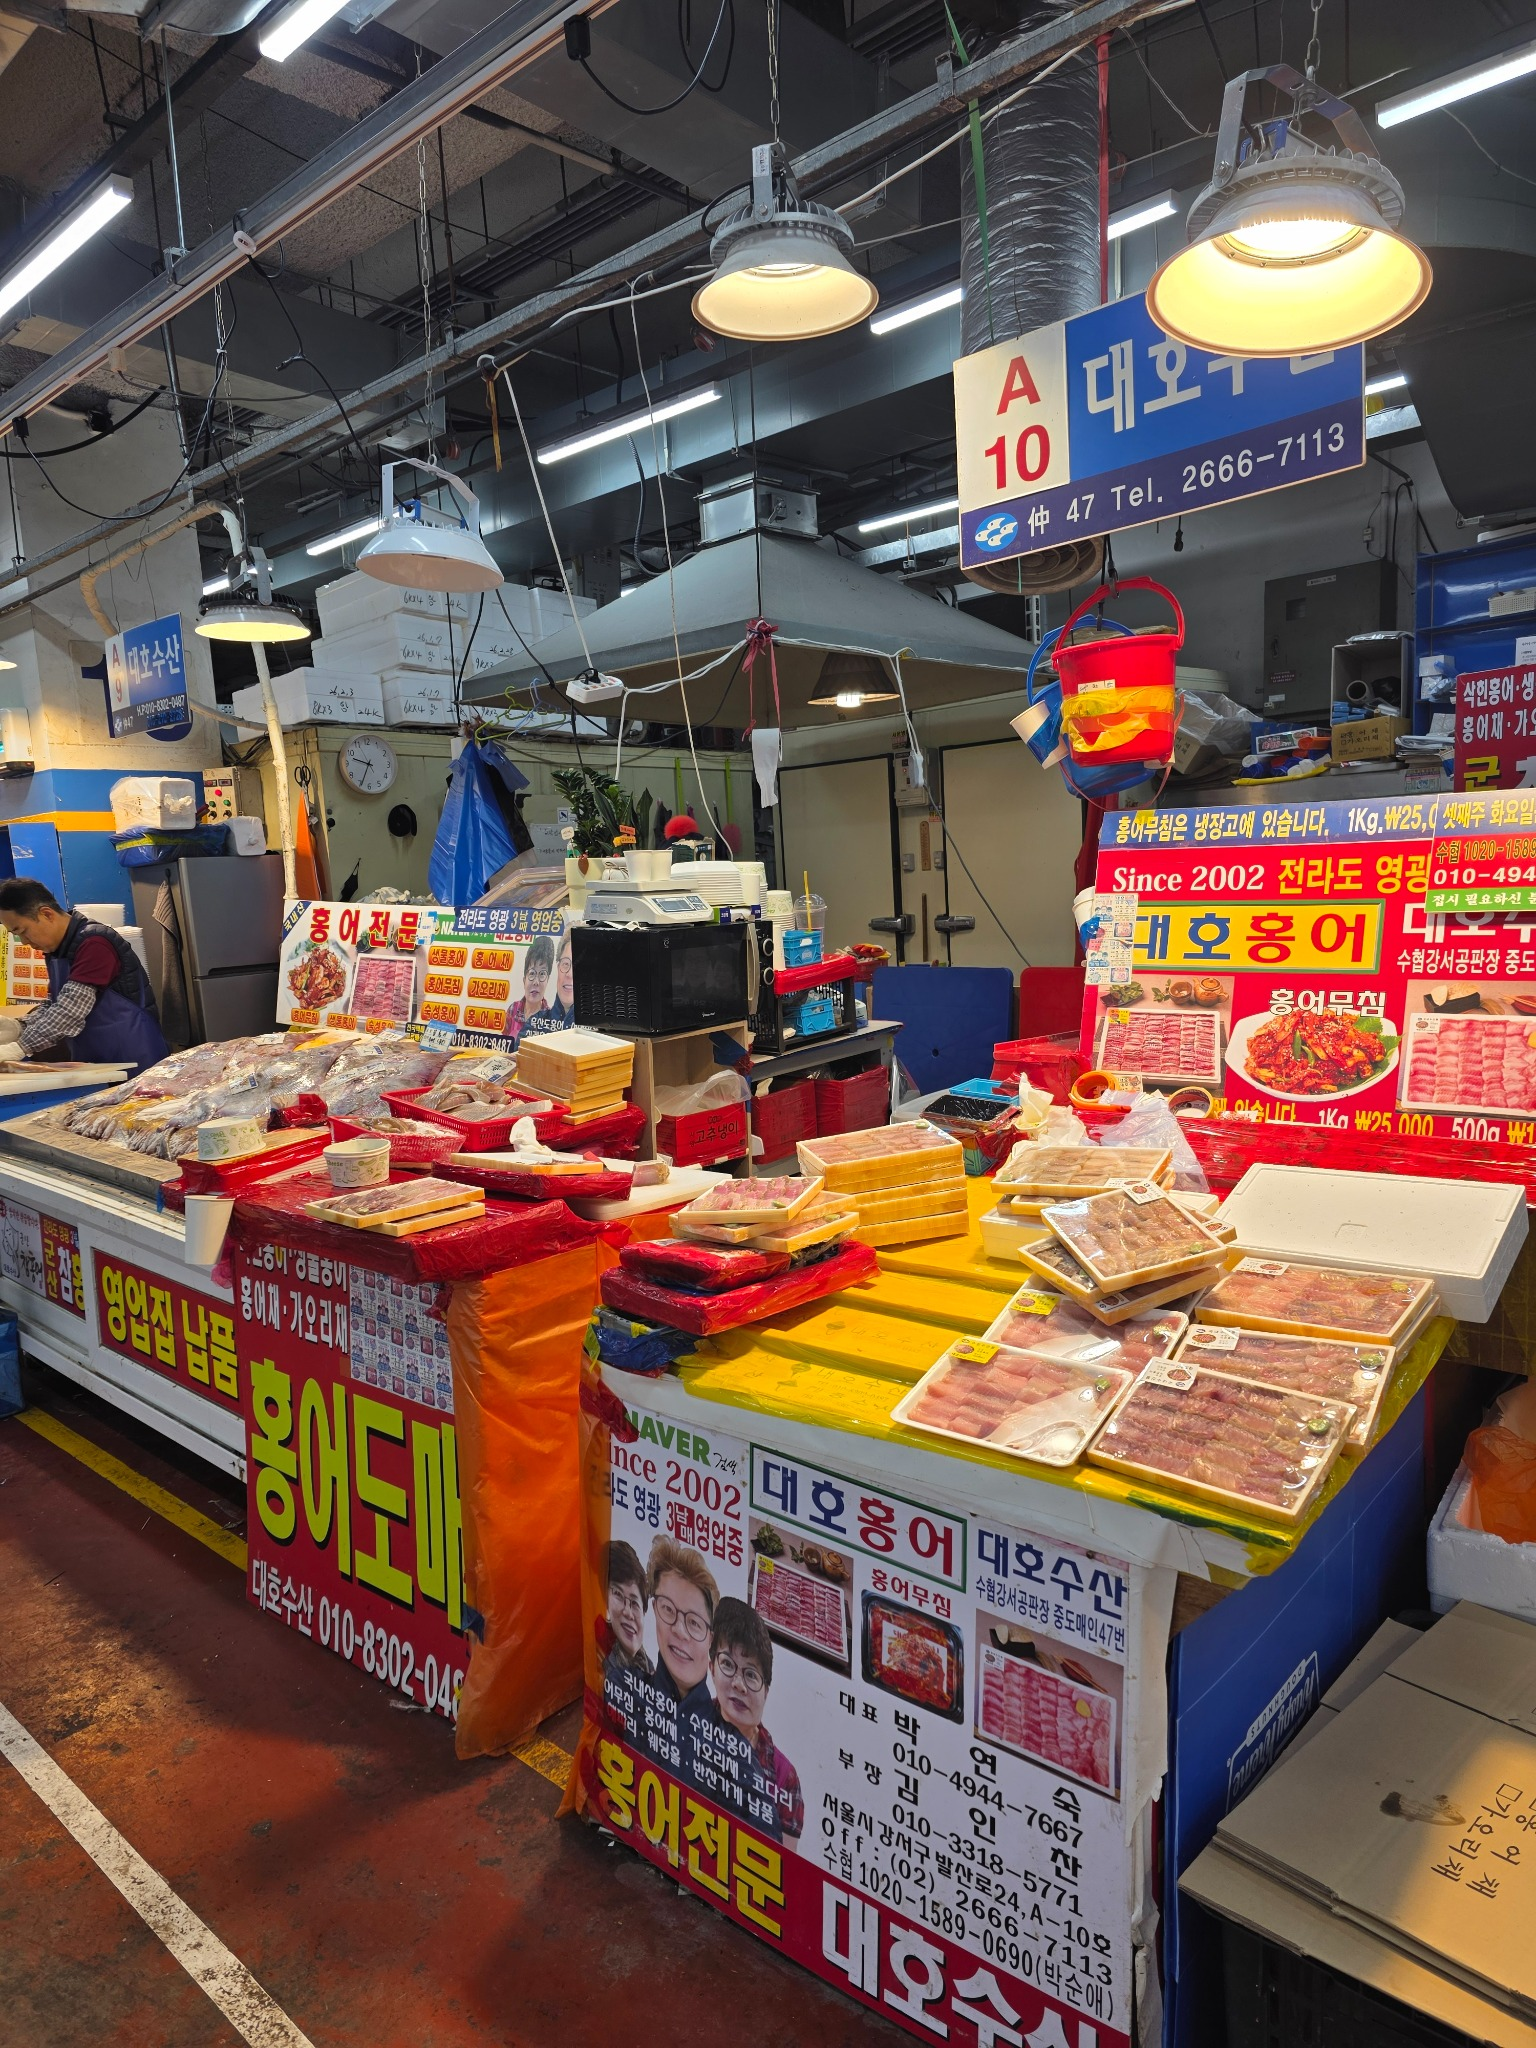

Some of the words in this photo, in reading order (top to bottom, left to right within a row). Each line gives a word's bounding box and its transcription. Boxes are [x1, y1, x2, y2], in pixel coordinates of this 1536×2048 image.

[997, 355, 1041, 416] A
[1082, 337, 1335, 433] 대호
[985, 424, 1051, 490] 10
[1028, 504, 1050, 538] 仲
[1066, 493, 1095, 523] 47
[1111, 477, 1163, 511] Tel.
[1182, 422, 1345, 493] 2666-7113
[112, 643, 121, 668] A
[128, 634, 180, 684] 대호수산
[116, 680, 123, 702] 9
[1116, 813, 1187, 844] 홍어무침은
[1194, 810, 1255, 841] 냉장고에
[1261, 807, 1329, 838] 있습니다.
[1442, 800, 1486, 830] 셋째주
[1112, 867, 1183, 892] Since
[1190, 864, 1265, 891] 2002
[1277, 857, 1363, 895] 전라도
[1436, 840, 1461, 865] 수협
[283, 902, 305, 932] 국내산
[458, 909, 487, 929] 전라도
[489, 910, 509, 931] 영광
[1432, 893, 1460, 907] 접시
[1465, 891, 1521, 906] 필요하신
[310, 907, 419, 950] 홍어전문
[1134, 912, 1368, 964] 대호홍어
[431, 948, 465, 966] 생물홍어
[1397, 948, 1500, 975] 수협강서공판장
[428, 976, 461, 994] 홍어무침
[472, 980, 506, 998] 가오리채
[1268, 988, 1387, 1018] 홍어무침
[424, 1003, 457, 1020] 숙성홍어
[452, 1033, 512, 1052] 010-8302-0487
[694, 1120, 738, 1143] 고추냉이
[102, 1265, 176, 1367] 영업집
[181, 1299, 238, 1399] 납품
[713, 1453, 737, 1475] 검색
[250, 1358, 467, 1630] 홍어도매
[634, 1485, 661, 1528] 영광
[666, 1460, 741, 1521] 2002
[763, 1460, 953, 1576] 대호홍어
[871, 1568, 951, 1618] 홍어무침
[978, 1529, 1127, 1620] 대호수산
[976, 1576, 1049, 1625] 수협강서공판장
[1054, 1604, 1124, 1653] 중도매인47번
[252, 1559, 314, 1637] 대호수산
[319, 1596, 465, 1724] 010-8302-048
[623, 1669, 677, 1720] 국내산홍어
[689, 1713, 752, 1765] 수입산홍어
[840, 1691, 878, 1723] 대표
[1251, 1666, 1303, 1738] DOUGHNUTS
[644, 1706, 678, 1743] 홍어채
[689, 1734, 739, 1780] 가오리채
[752, 1772, 793, 1812] 코다리
[647, 1731, 681, 1768] 웨딩홀
[693, 1759, 743, 1806] 반찬가게
[748, 1792, 773, 1825] 납품
[893, 1743, 1083, 1848] 010-4944-7667
[597, 1737, 785, 1938] 홍어전문
[823, 1841, 853, 1883] 수협
[893, 1804, 1083, 1917] 010-3318-5771
[1430, 1797, 1510, 1883] 가오리채
[890, 1853, 936, 1894] (02)
[955, 1889, 1112, 1986] 2666-7113
